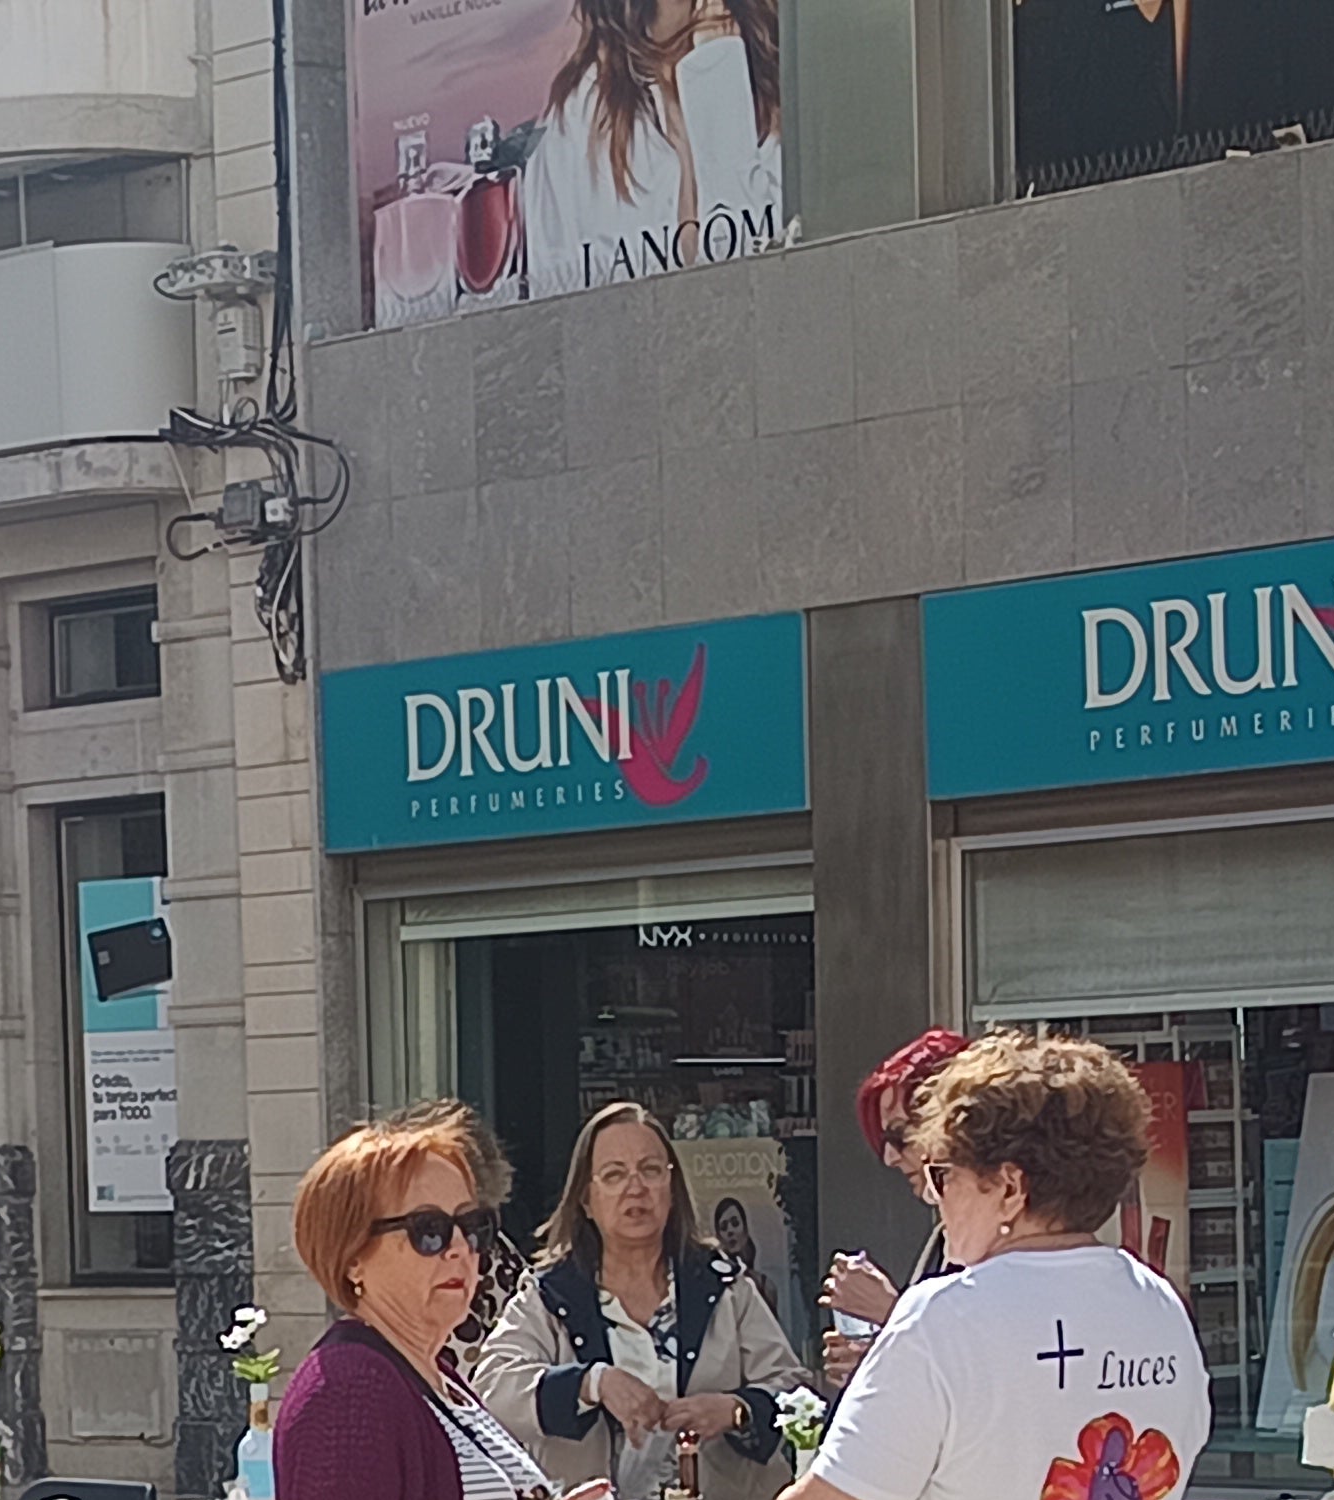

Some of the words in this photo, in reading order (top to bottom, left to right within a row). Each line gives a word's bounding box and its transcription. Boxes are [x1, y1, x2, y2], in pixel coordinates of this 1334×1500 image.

[404, 668, 633, 783] DRUNI
[410, 778, 626, 819] PERFUMERIES
[638, 924, 693, 948] NYX
[693, 1150, 780, 1177] DEVOTION
[1096, 1350, 1178, 1390] Luces
